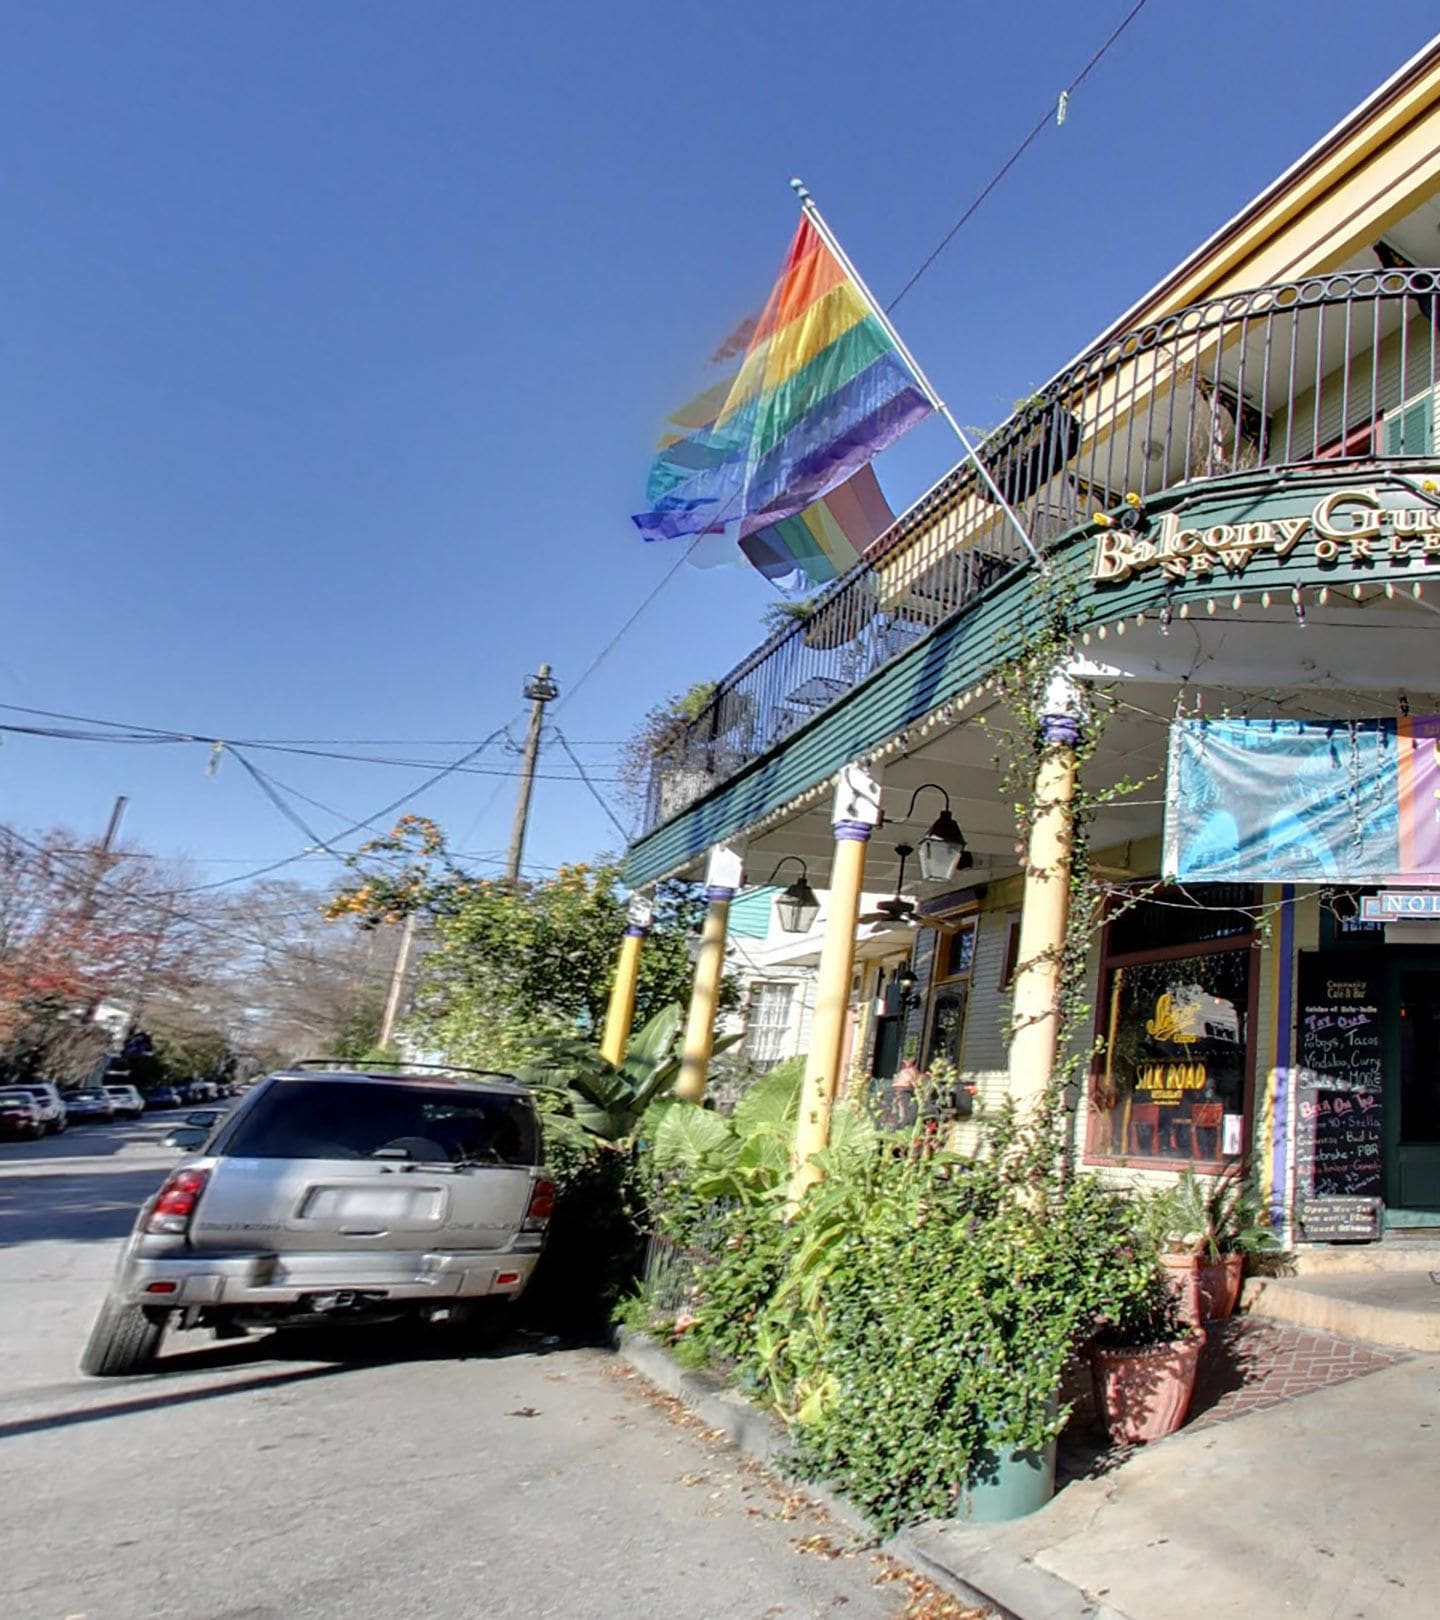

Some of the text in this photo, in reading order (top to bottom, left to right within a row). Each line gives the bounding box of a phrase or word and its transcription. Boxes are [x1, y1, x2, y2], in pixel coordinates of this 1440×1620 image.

[1087, 512, 1311, 583] Balcony
[1161, 547, 1252, 580] NEW
[1344, 1028, 1379, 1046] Tacos
[1166, 1062, 1207, 1090] ROAD
